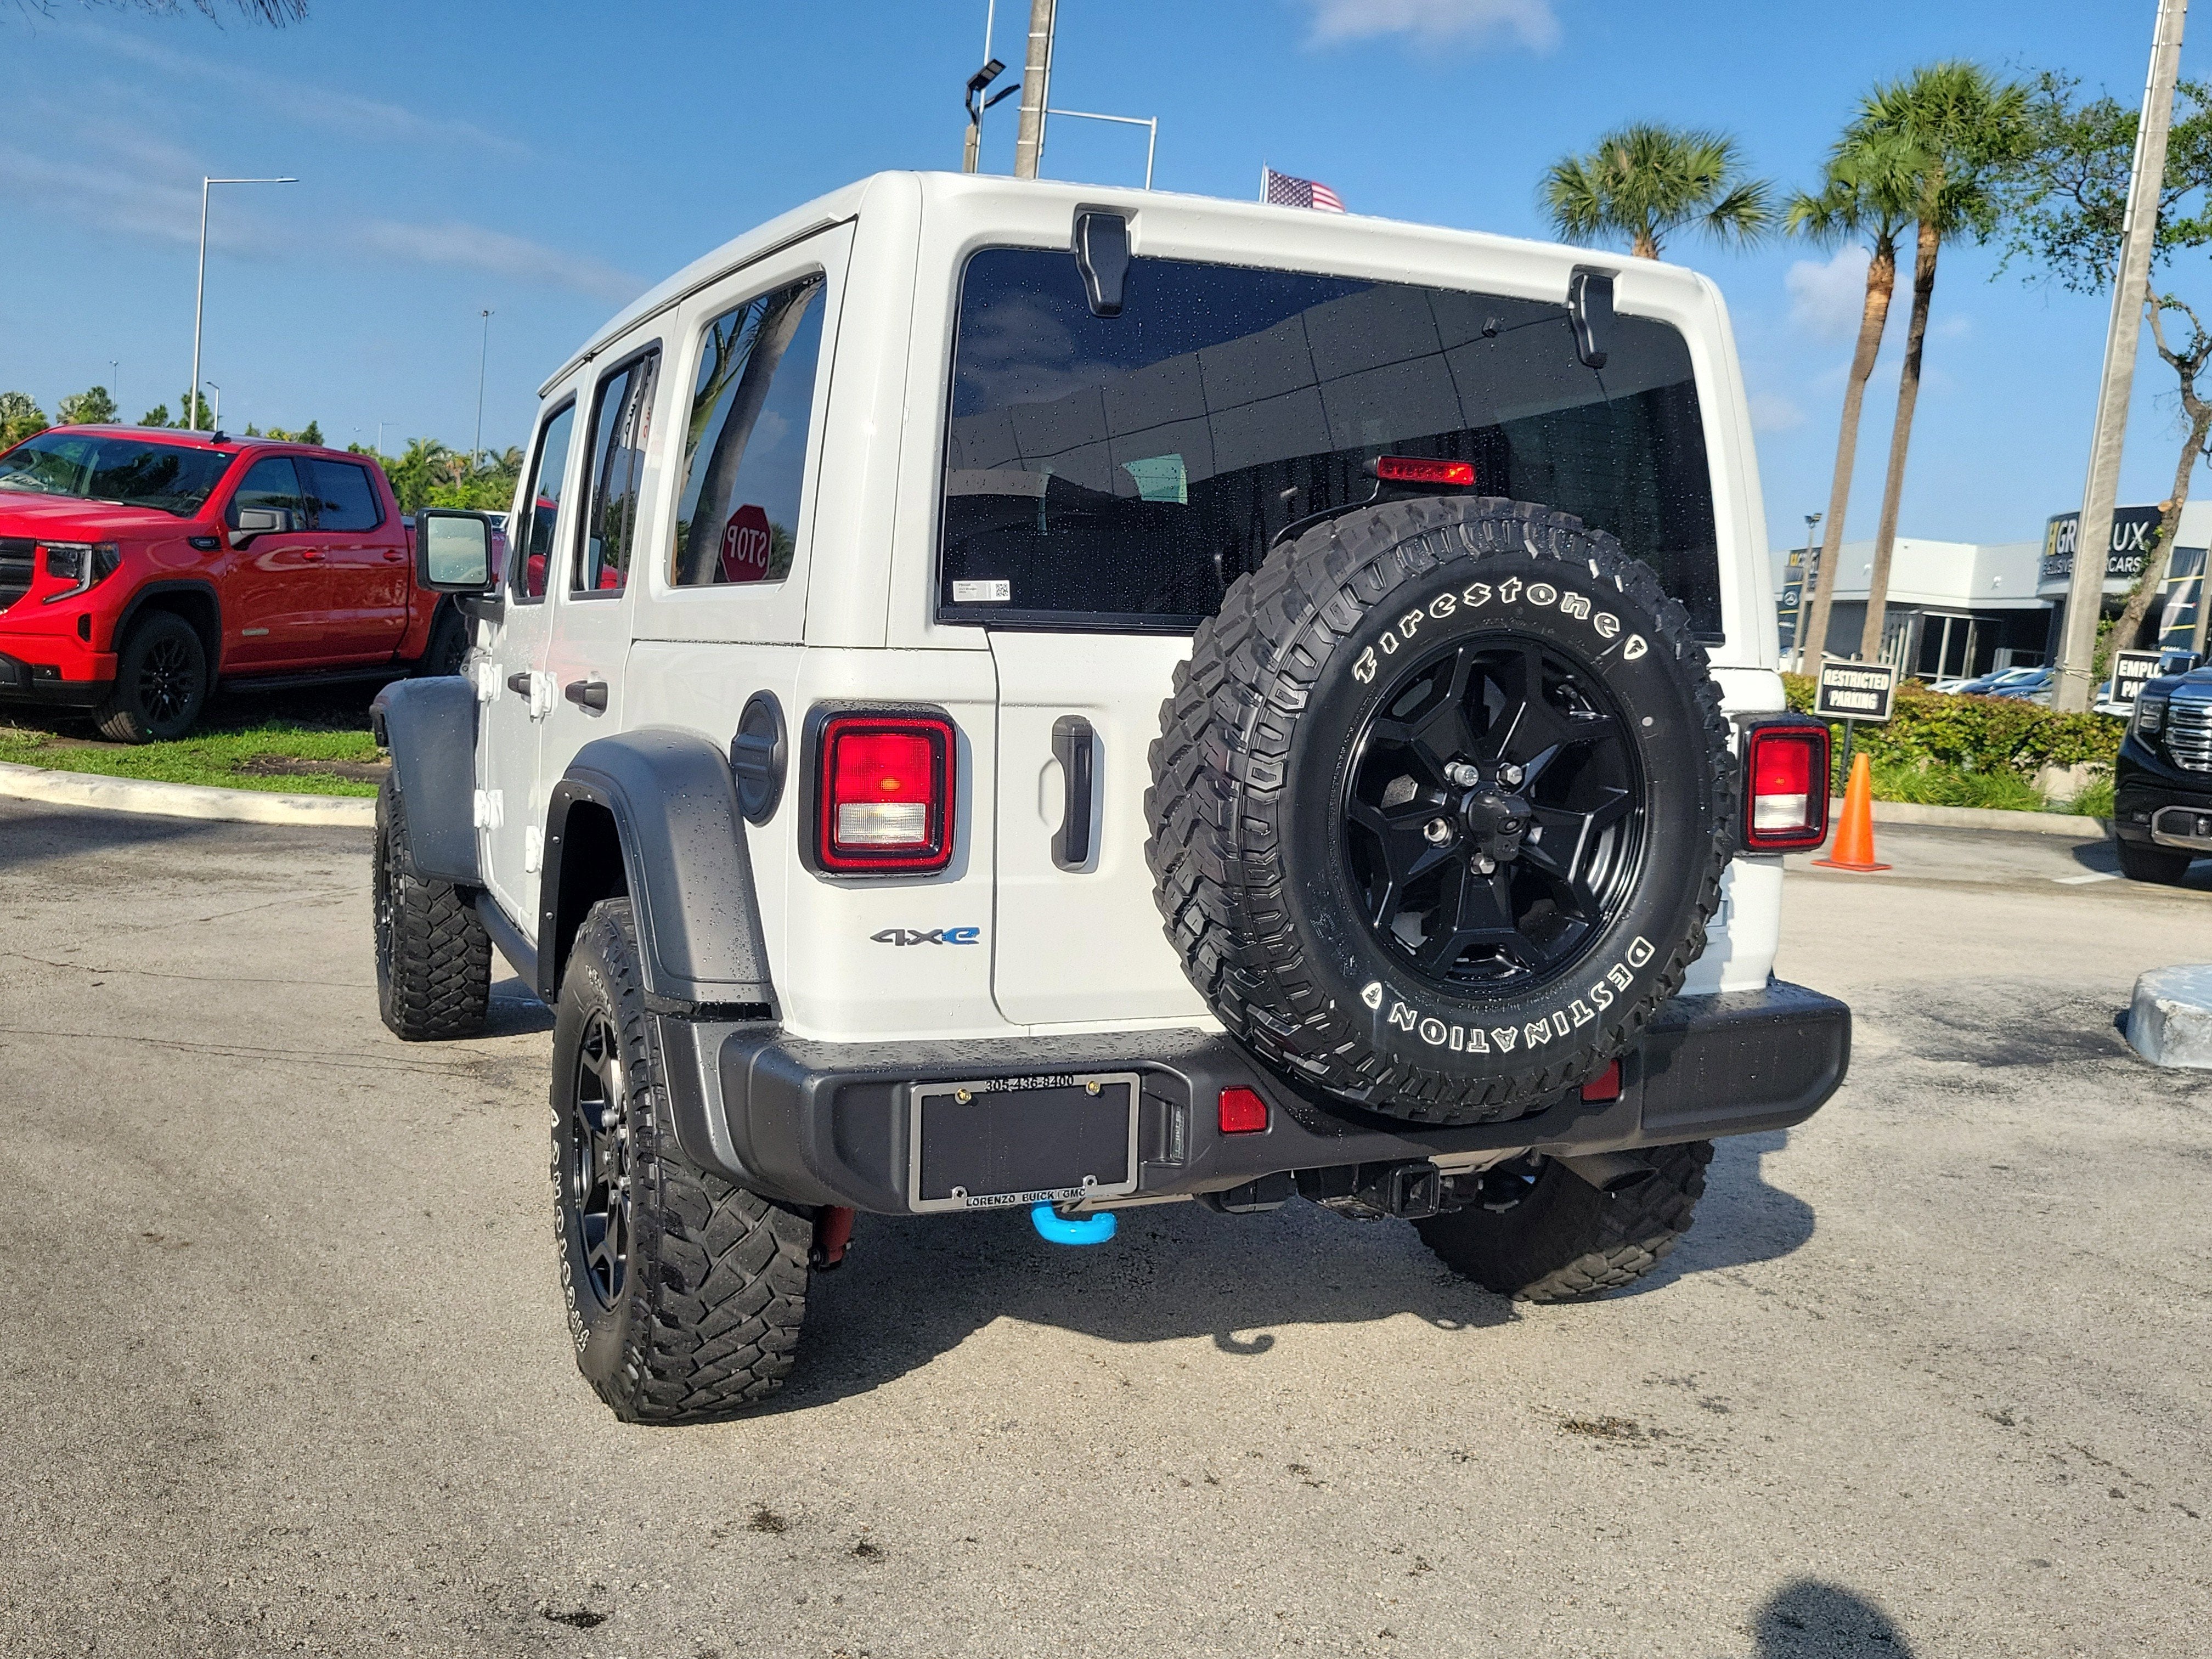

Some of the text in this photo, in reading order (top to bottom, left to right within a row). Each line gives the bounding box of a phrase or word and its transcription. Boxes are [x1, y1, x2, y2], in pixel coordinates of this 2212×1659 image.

[1352, 575, 1621, 684] Firestone
[2119, 659, 2163, 679] EMPLO
[1823, 668, 1890, 691] RESTRICTED
[1829, 690, 1878, 710] PARKING
[1389, 936, 1656, 1053] DESTINATION
[985, 1075, 1074, 1091] 305-436-8400
[966, 1188, 1086, 1207] LORENZO BUICK GMC
